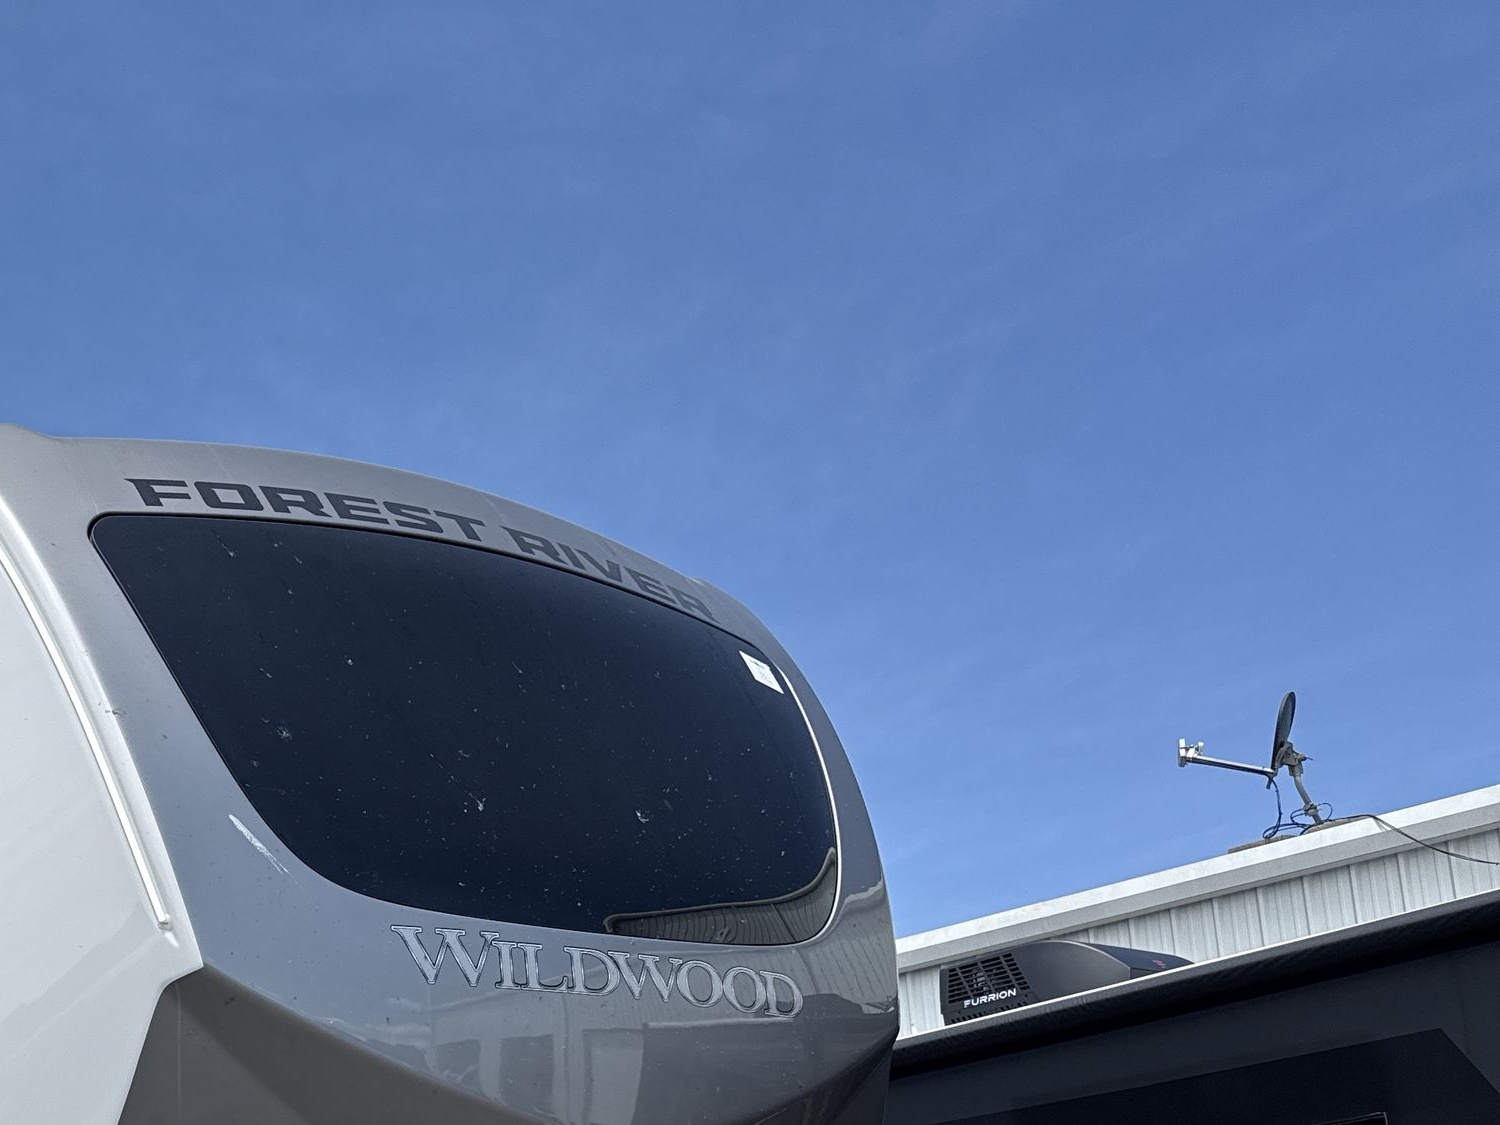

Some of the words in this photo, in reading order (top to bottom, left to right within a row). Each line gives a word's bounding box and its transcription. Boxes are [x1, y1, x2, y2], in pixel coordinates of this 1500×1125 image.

[123, 477, 487, 543] FOREST
[499, 525, 722, 625] RIVER
[390, 924, 804, 1019] WILDWOOD
[963, 987, 1017, 1009] FURRION
